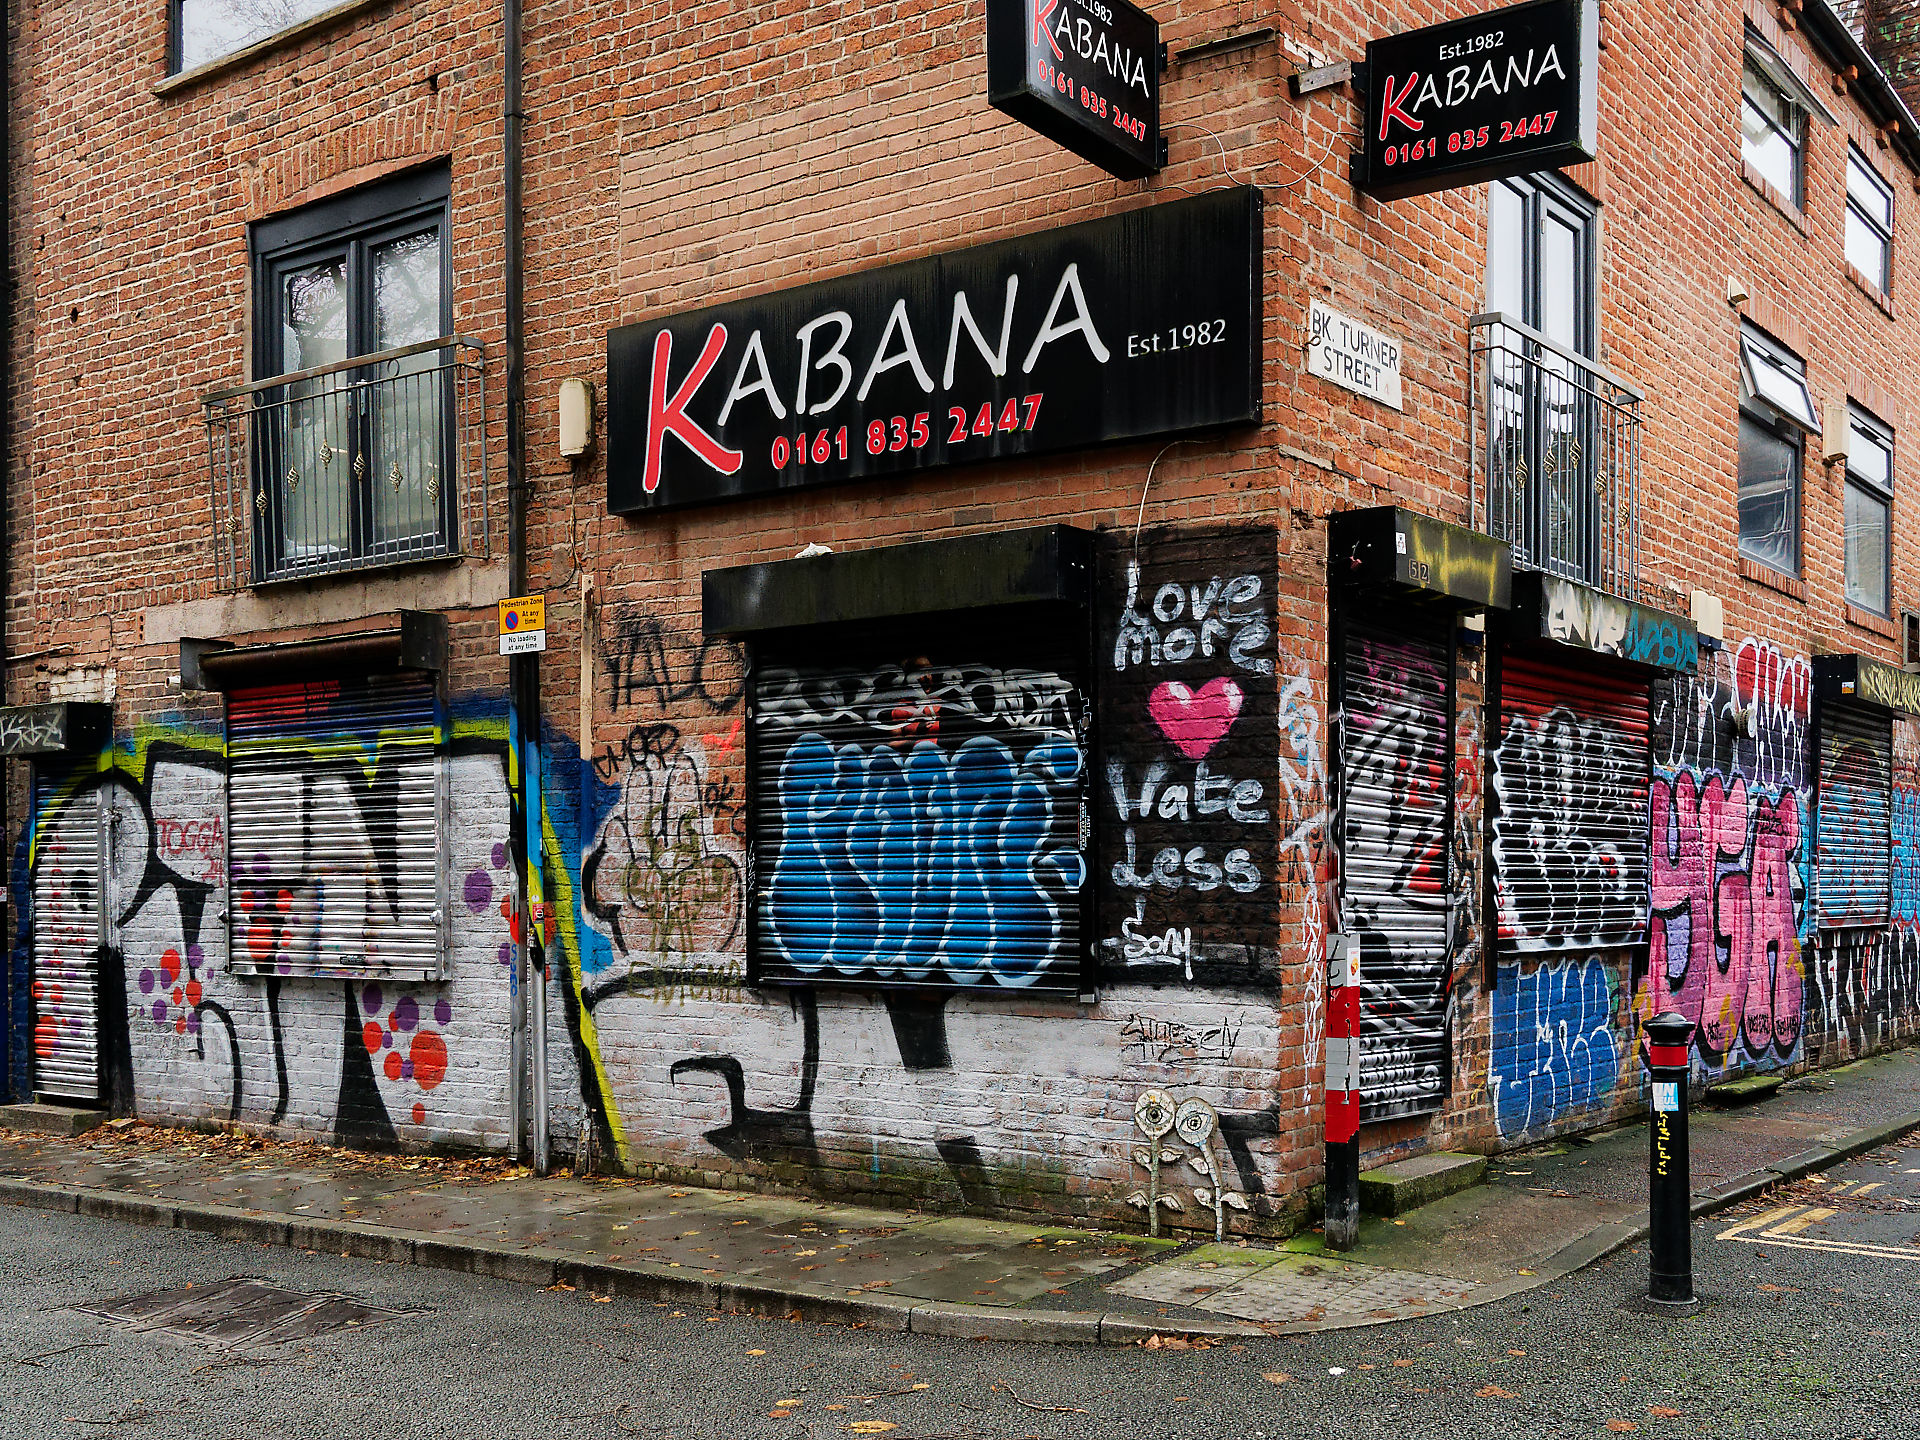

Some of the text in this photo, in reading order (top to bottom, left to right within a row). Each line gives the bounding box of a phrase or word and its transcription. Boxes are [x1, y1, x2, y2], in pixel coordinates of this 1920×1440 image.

[1032, 0, 1150, 99] KABANA
[1439, 31, 1504, 61] Est.1982
[1037, 58, 1147, 142] 0161 835 2447
[1379, 43, 1566, 141] KABANA
[1384, 110, 1559, 166] 0161 835 2447
[1126, 319, 1227, 359] Est.1982
[1312, 307, 1398, 371] BK. TURNER
[1323, 345, 1381, 392] STREET
[642, 262, 1110, 494] KABANA
[771, 392, 1044, 471] 0161 835 2447
[1119, 561, 1266, 628] Love
[1409, 560, 1429, 582] 52
[500, 600, 529, 609] Pedestrian
[1114, 618, 1275, 675] more
[1104, 755, 1271, 824] Hate
[1111, 827, 1262, 893] Less
